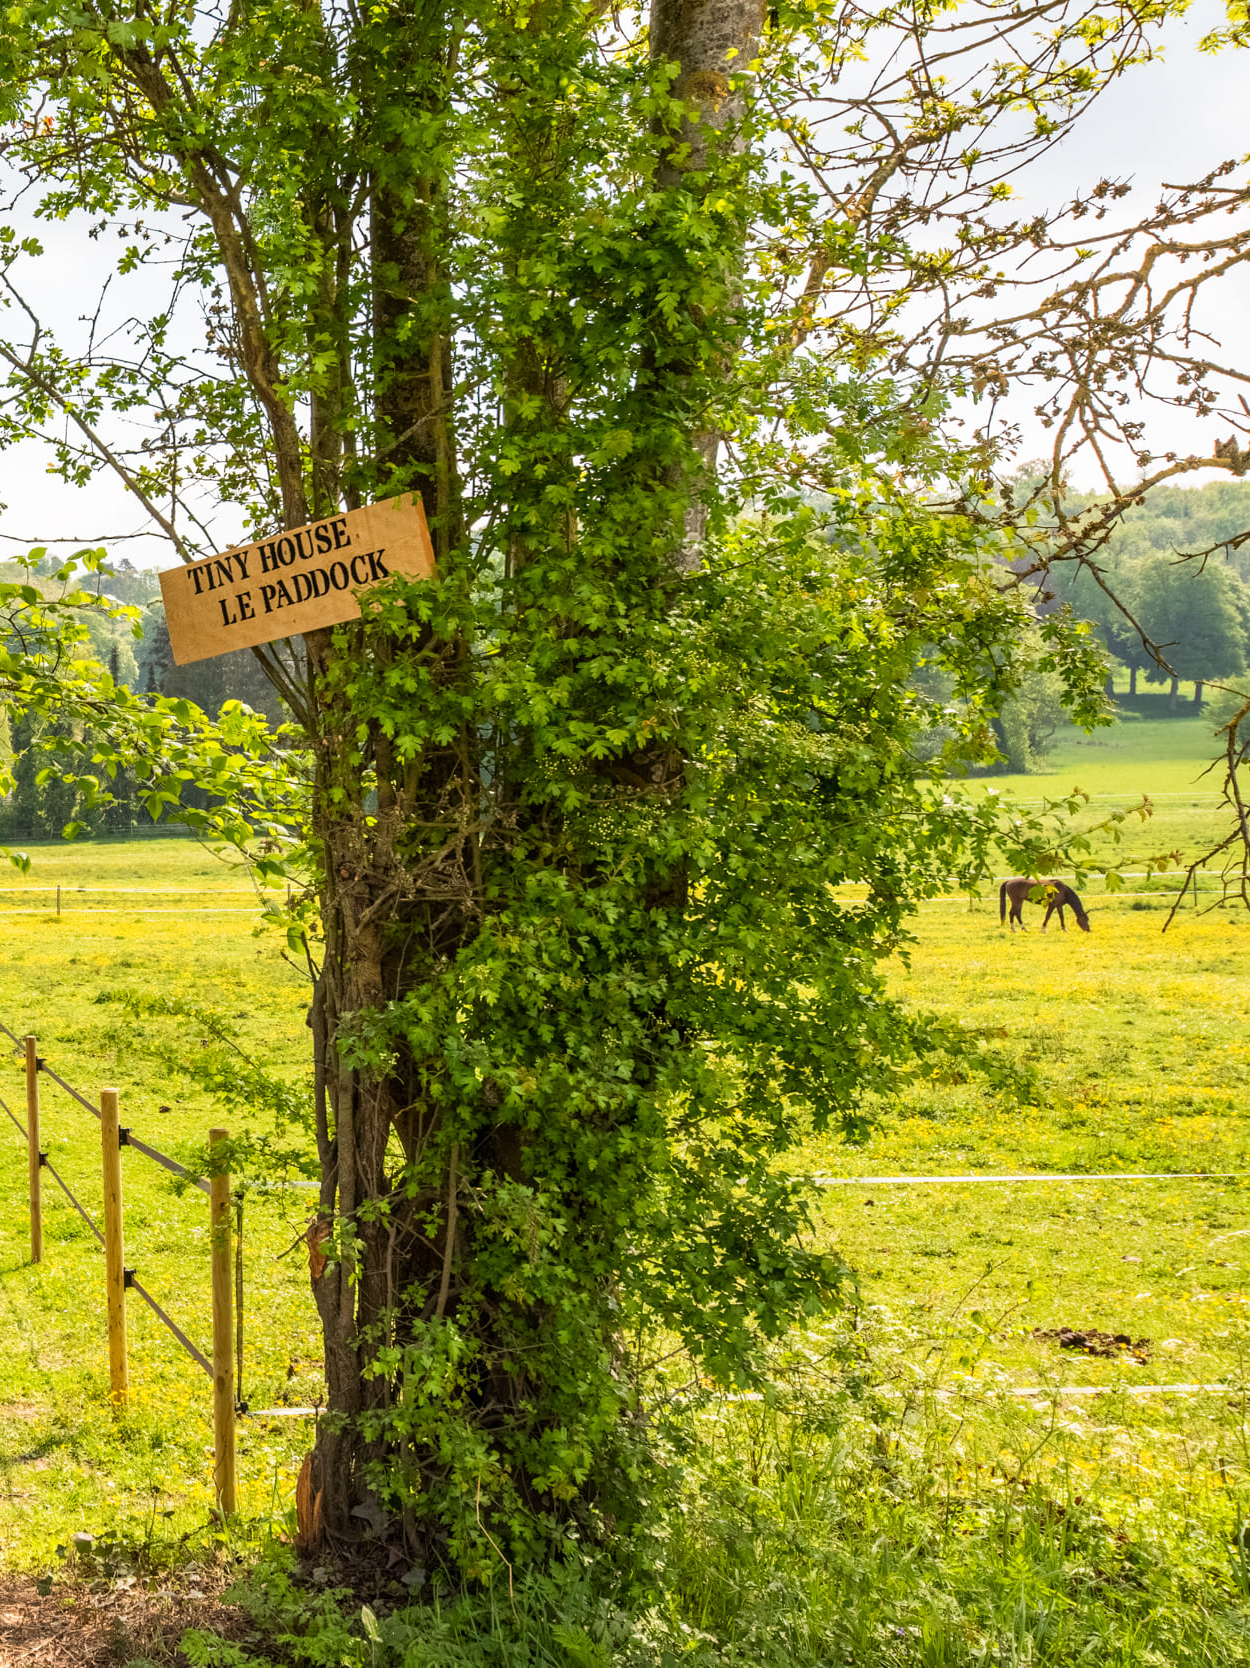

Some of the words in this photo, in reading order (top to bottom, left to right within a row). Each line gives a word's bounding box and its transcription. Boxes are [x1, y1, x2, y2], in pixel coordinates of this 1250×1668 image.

[187, 550, 250, 595] TINY
[257, 518, 352, 574] HOUSE
[218, 591, 256, 627] LE
[259, 548, 390, 614] PADDOCK
